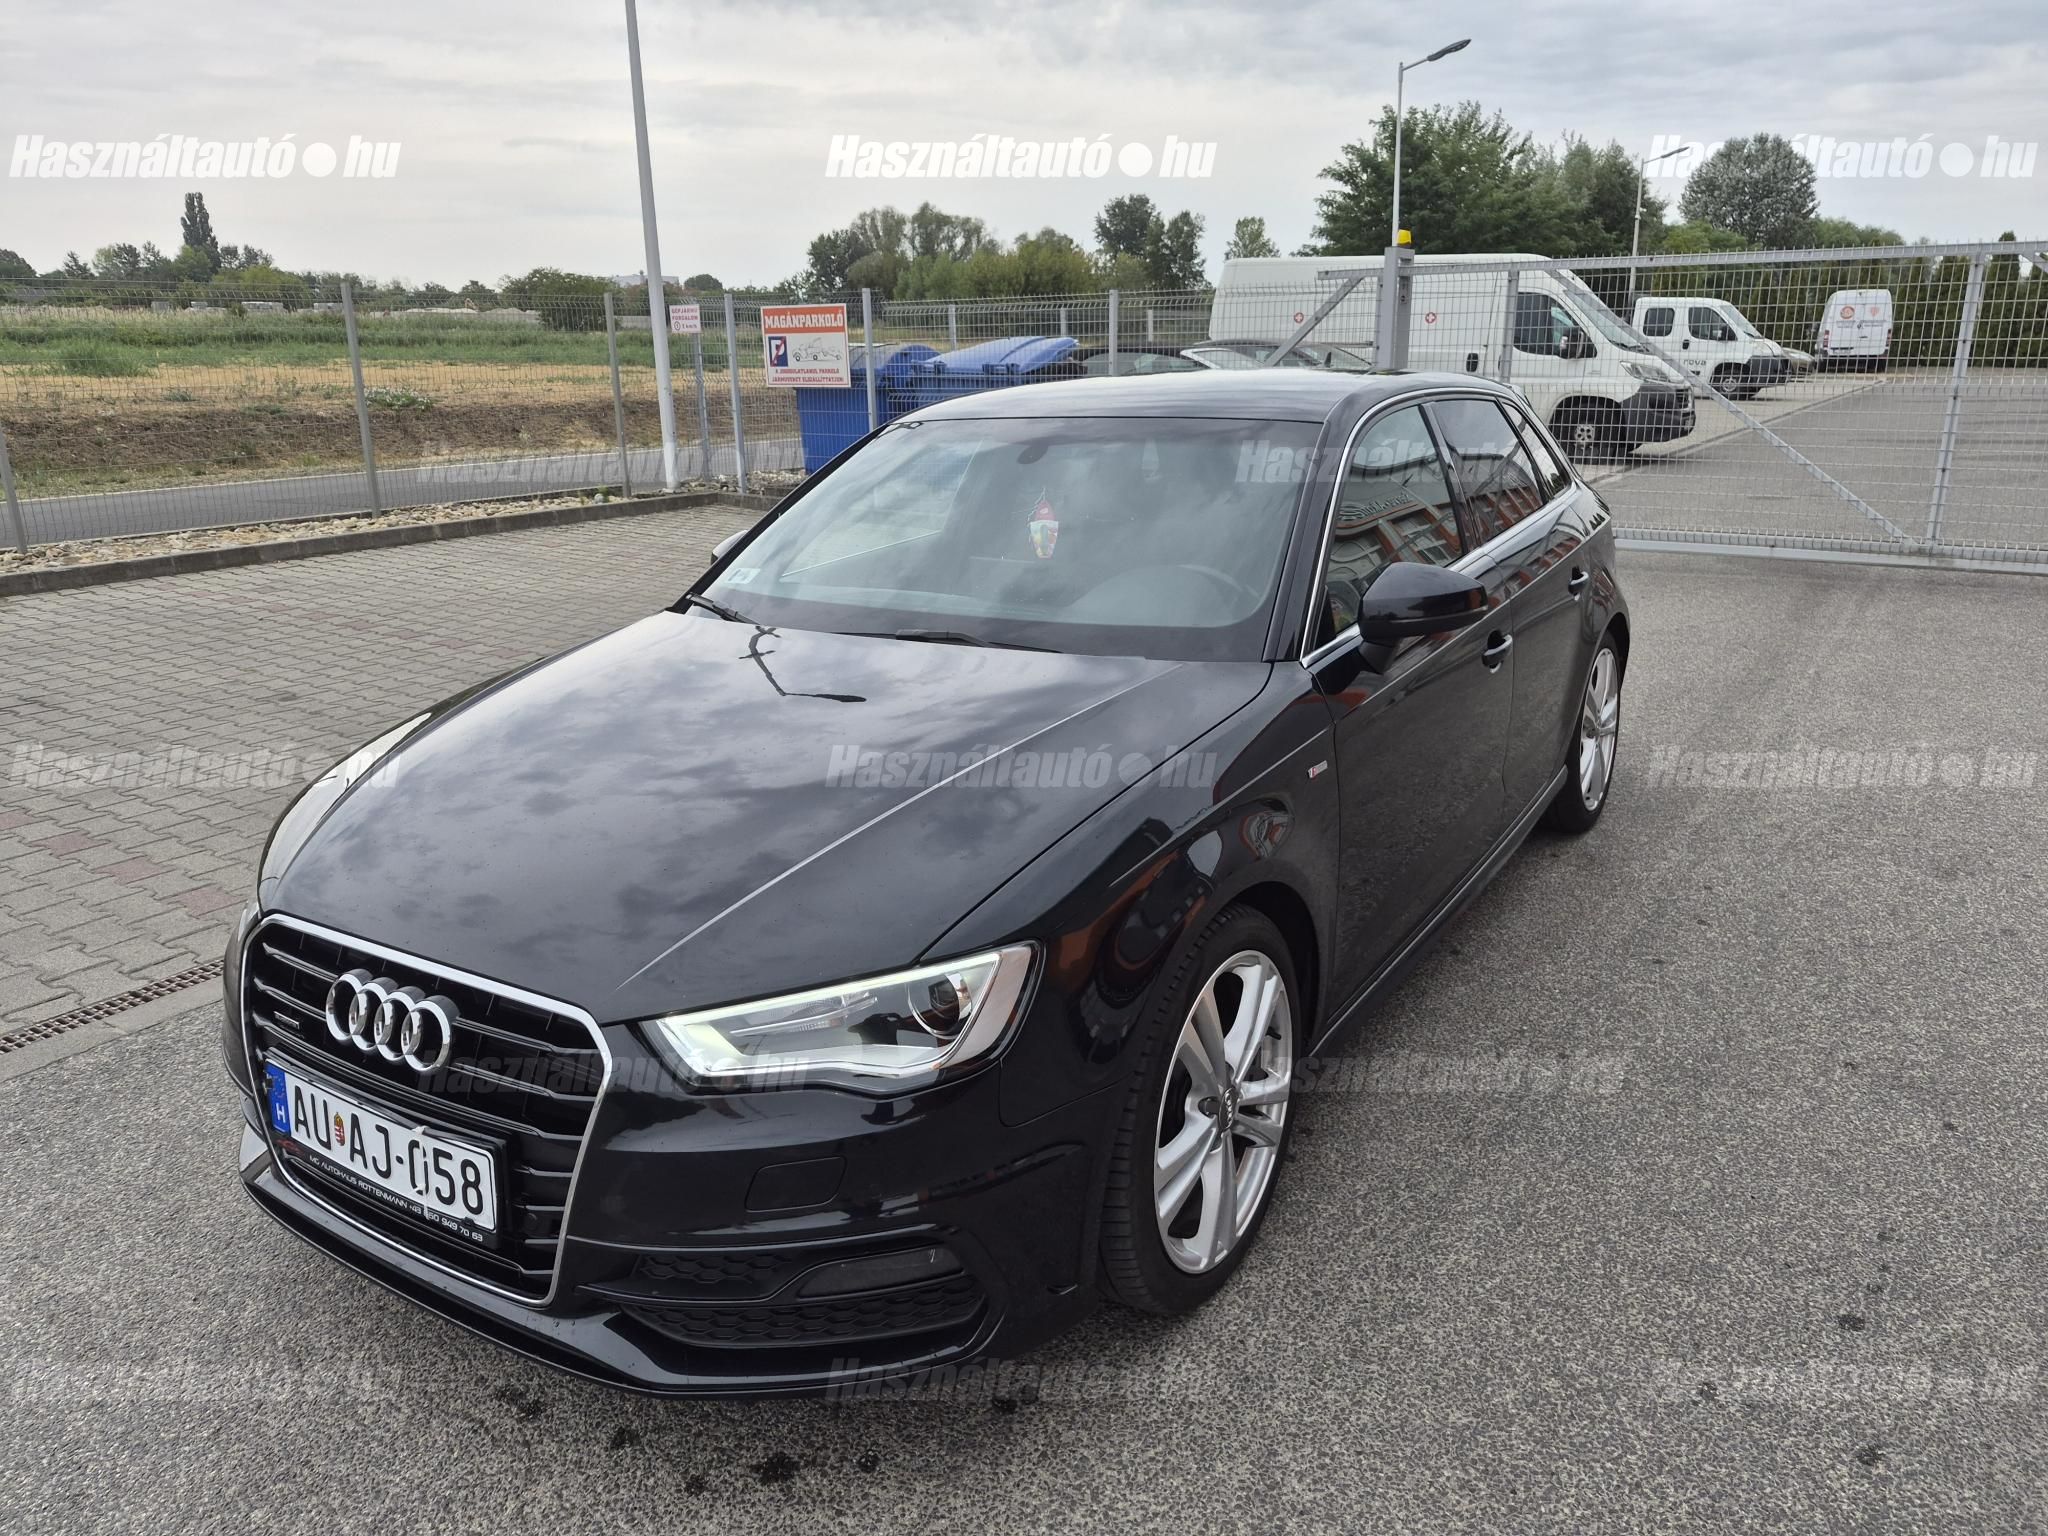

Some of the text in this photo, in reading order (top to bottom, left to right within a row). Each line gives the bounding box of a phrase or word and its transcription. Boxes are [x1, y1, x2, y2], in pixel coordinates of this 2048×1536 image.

[764, 309, 844, 329] MAGÁNPARKOLÓ
[276, 1103, 287, 1123] H
[320, 1162, 357, 1185] AUTOHAUS
[357, 1180, 408, 1209] ROTTENMANN
[441, 1217, 458, 1231] 949
[459, 1225, 470, 1237] 70
[471, 1231, 483, 1242] 63
